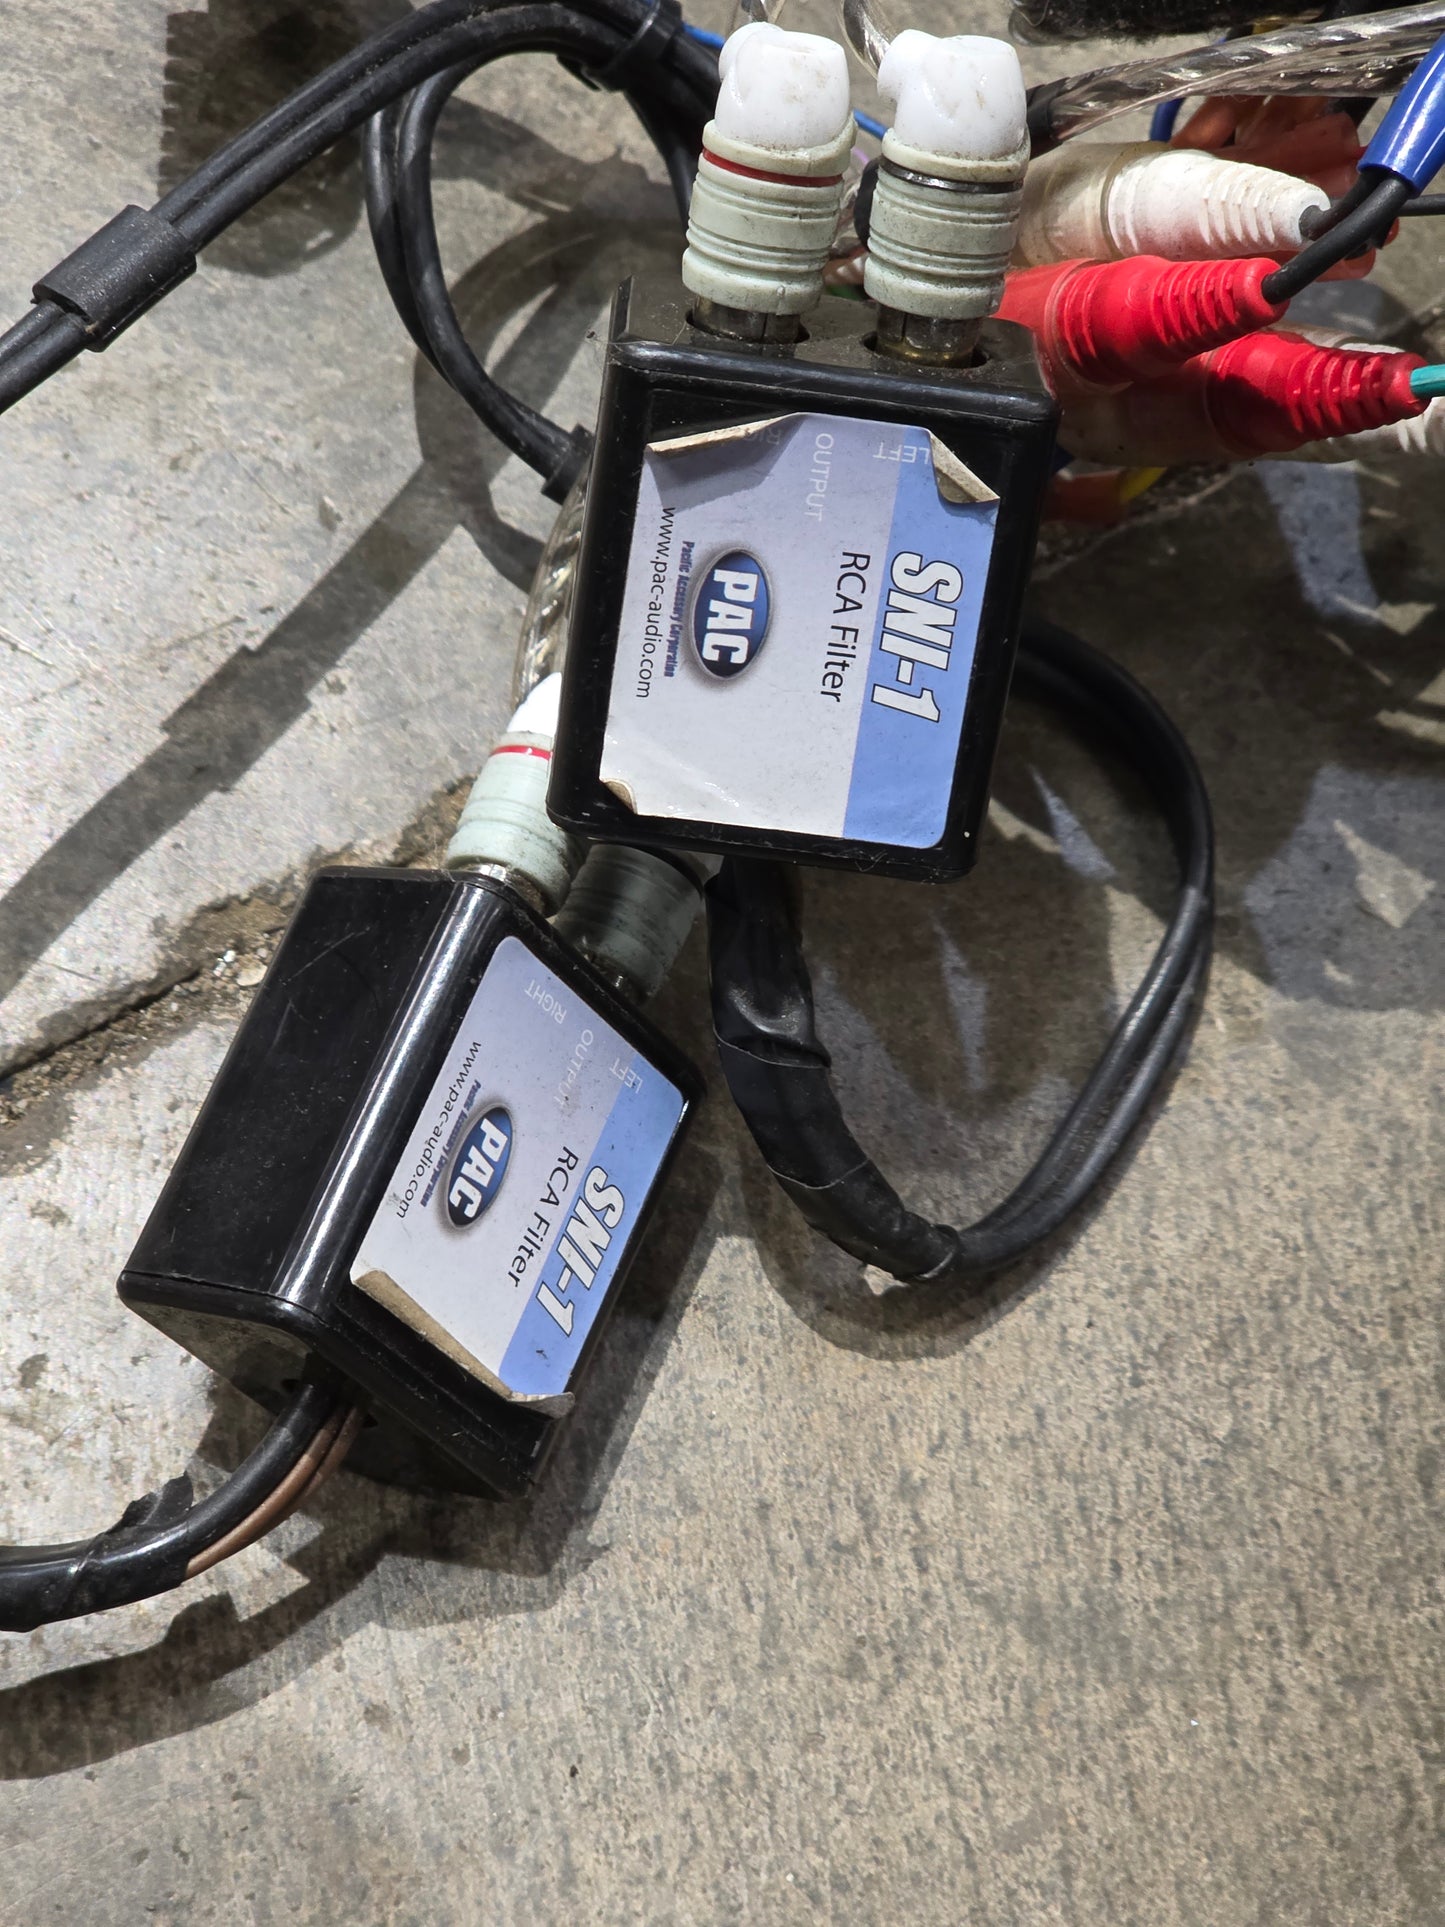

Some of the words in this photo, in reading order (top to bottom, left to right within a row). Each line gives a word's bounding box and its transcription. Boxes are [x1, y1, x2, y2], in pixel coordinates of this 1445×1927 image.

[803, 432, 835, 522] OUTPUT
[872, 442, 930, 465] LEFT
[678, 540, 695, 574] Pacific
[832, 551, 871, 615] RCA
[635, 506, 676, 699] www.pac-audio.com
[669, 574, 690, 622] Accessory
[702, 568, 759, 665] PAC
[663, 623, 683, 678] Corporation
[820, 624, 859, 703] Filter
[871, 551, 963, 723] SNI-1
[524, 979, 567, 1025] RIGHT
[553, 1029, 594, 1107] OUTPUT
[608, 1058, 643, 1095] LEFT
[396, 1041, 482, 1219] www.pac-audio.com
[449, 1117, 508, 1219] PAC
[540, 1146, 579, 1207] RCA
[507, 1211, 552, 1288] Filter
[536, 1165, 626, 1337] SNI-1
